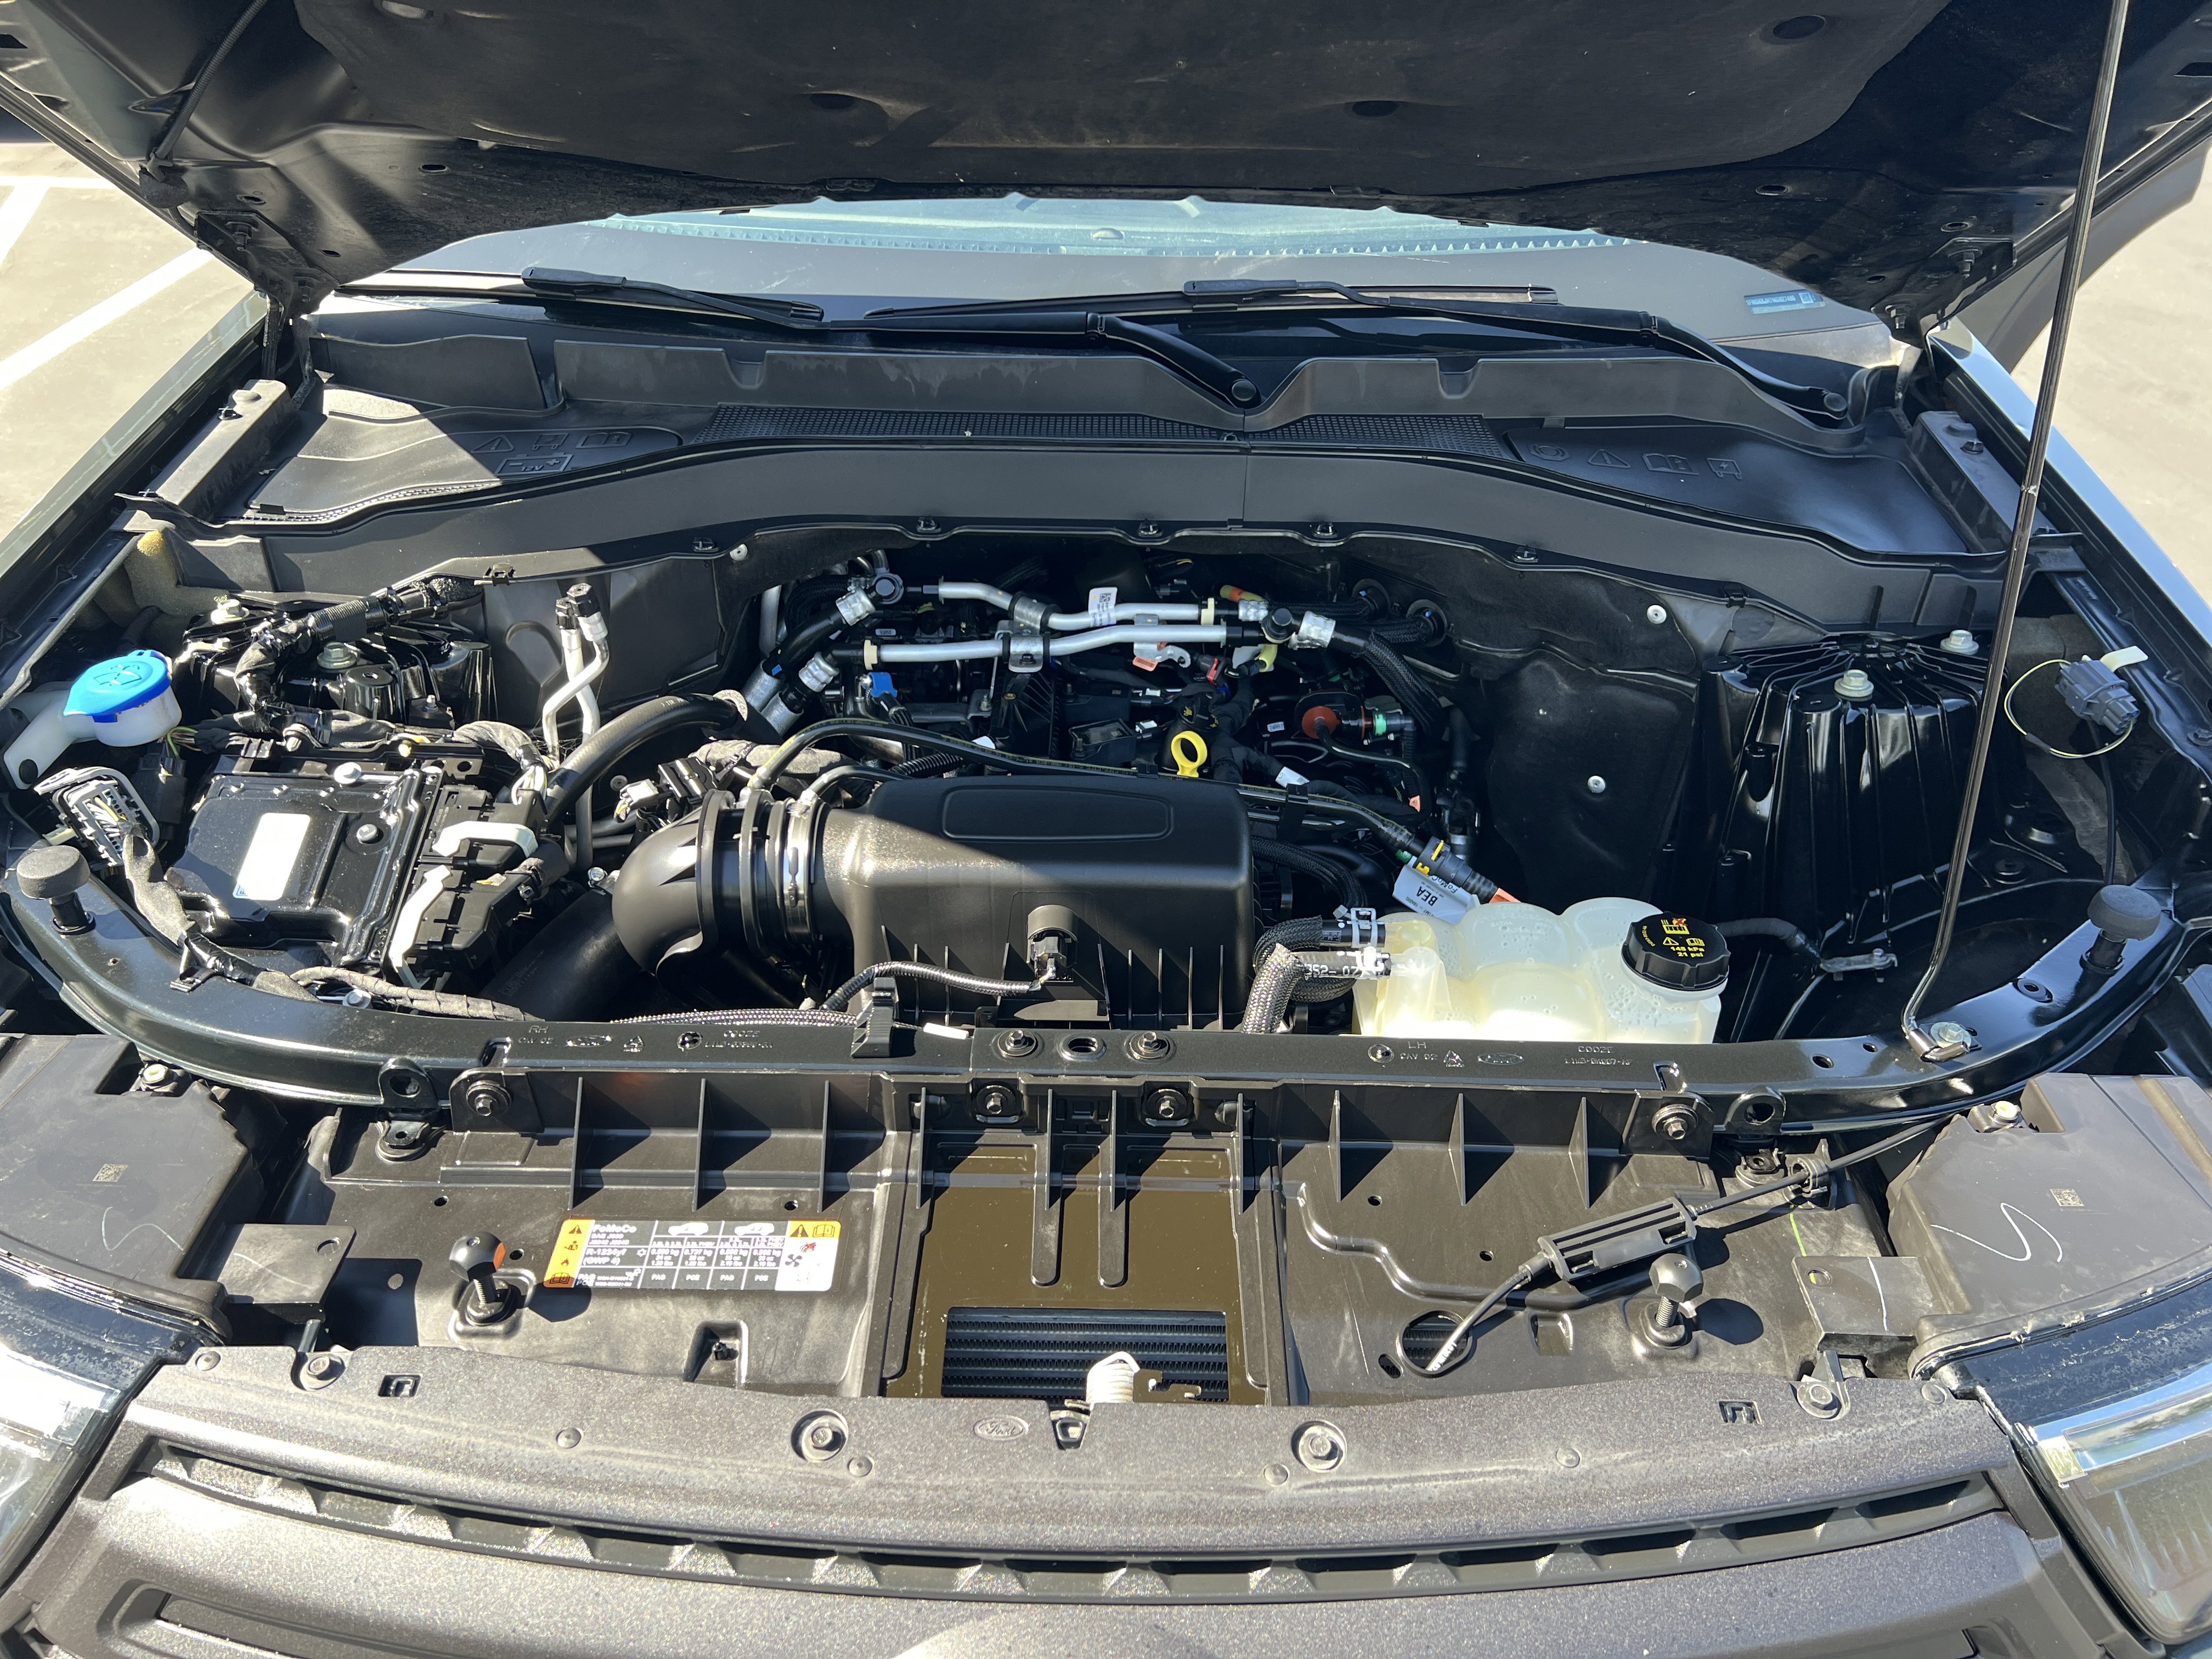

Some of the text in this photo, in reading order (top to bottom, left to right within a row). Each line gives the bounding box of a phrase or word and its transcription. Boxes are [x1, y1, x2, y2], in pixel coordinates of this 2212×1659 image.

[1431, 874, 1458, 893] FoMoC
[1415, 885, 1438, 907] BEA
[528, 1025, 549, 1034] RH
[1408, 1041, 1427, 1049] LH
[592, 1224, 637, 1233] FoMoCo
[586, 1249, 627, 1257] R-1234yf
[703, 1249, 713, 1257] kg
[583, 1257, 620, 1266] (GWP 4)
